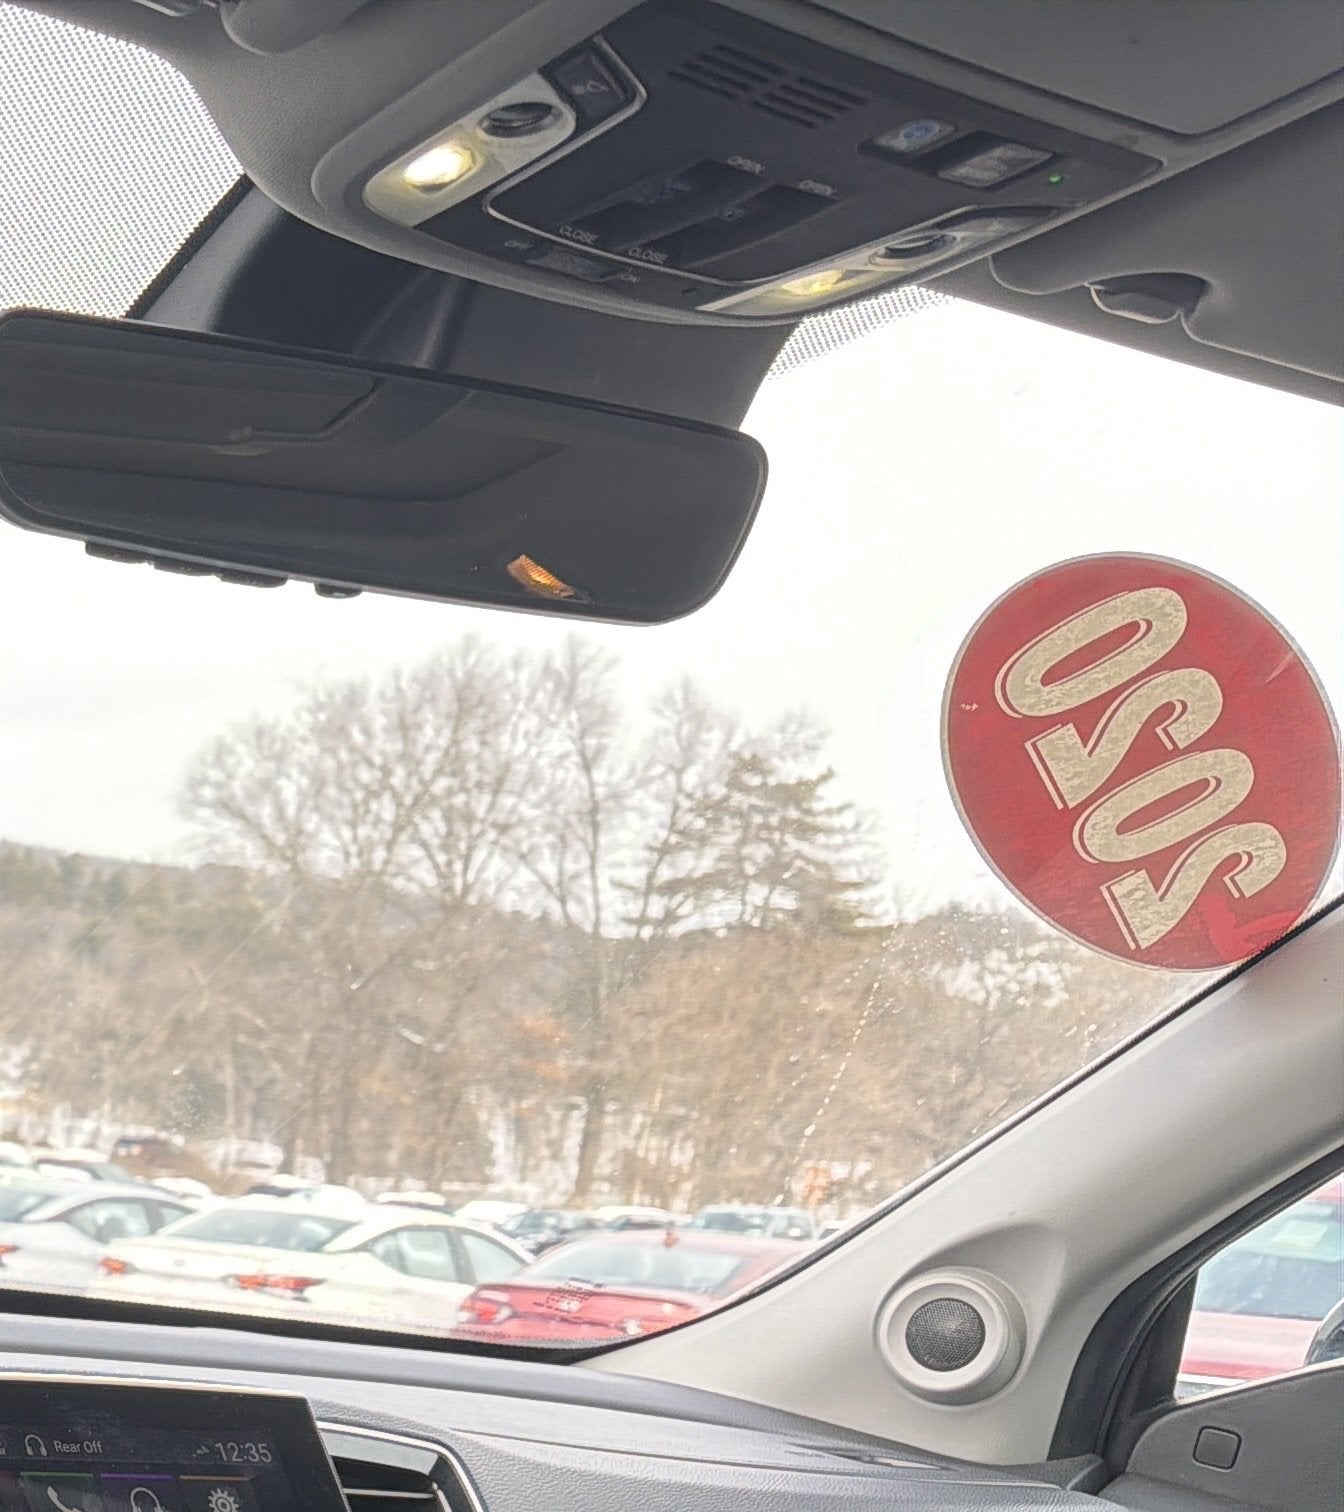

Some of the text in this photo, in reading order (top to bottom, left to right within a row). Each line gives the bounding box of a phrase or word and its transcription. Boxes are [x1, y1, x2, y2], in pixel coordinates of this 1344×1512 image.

[559, 225, 599, 244] CLOSE
[628, 246, 669, 264] CLOSE
[54, 1440, 103, 1454] Rear Off
[214, 1442, 272, 1463] 12:35
